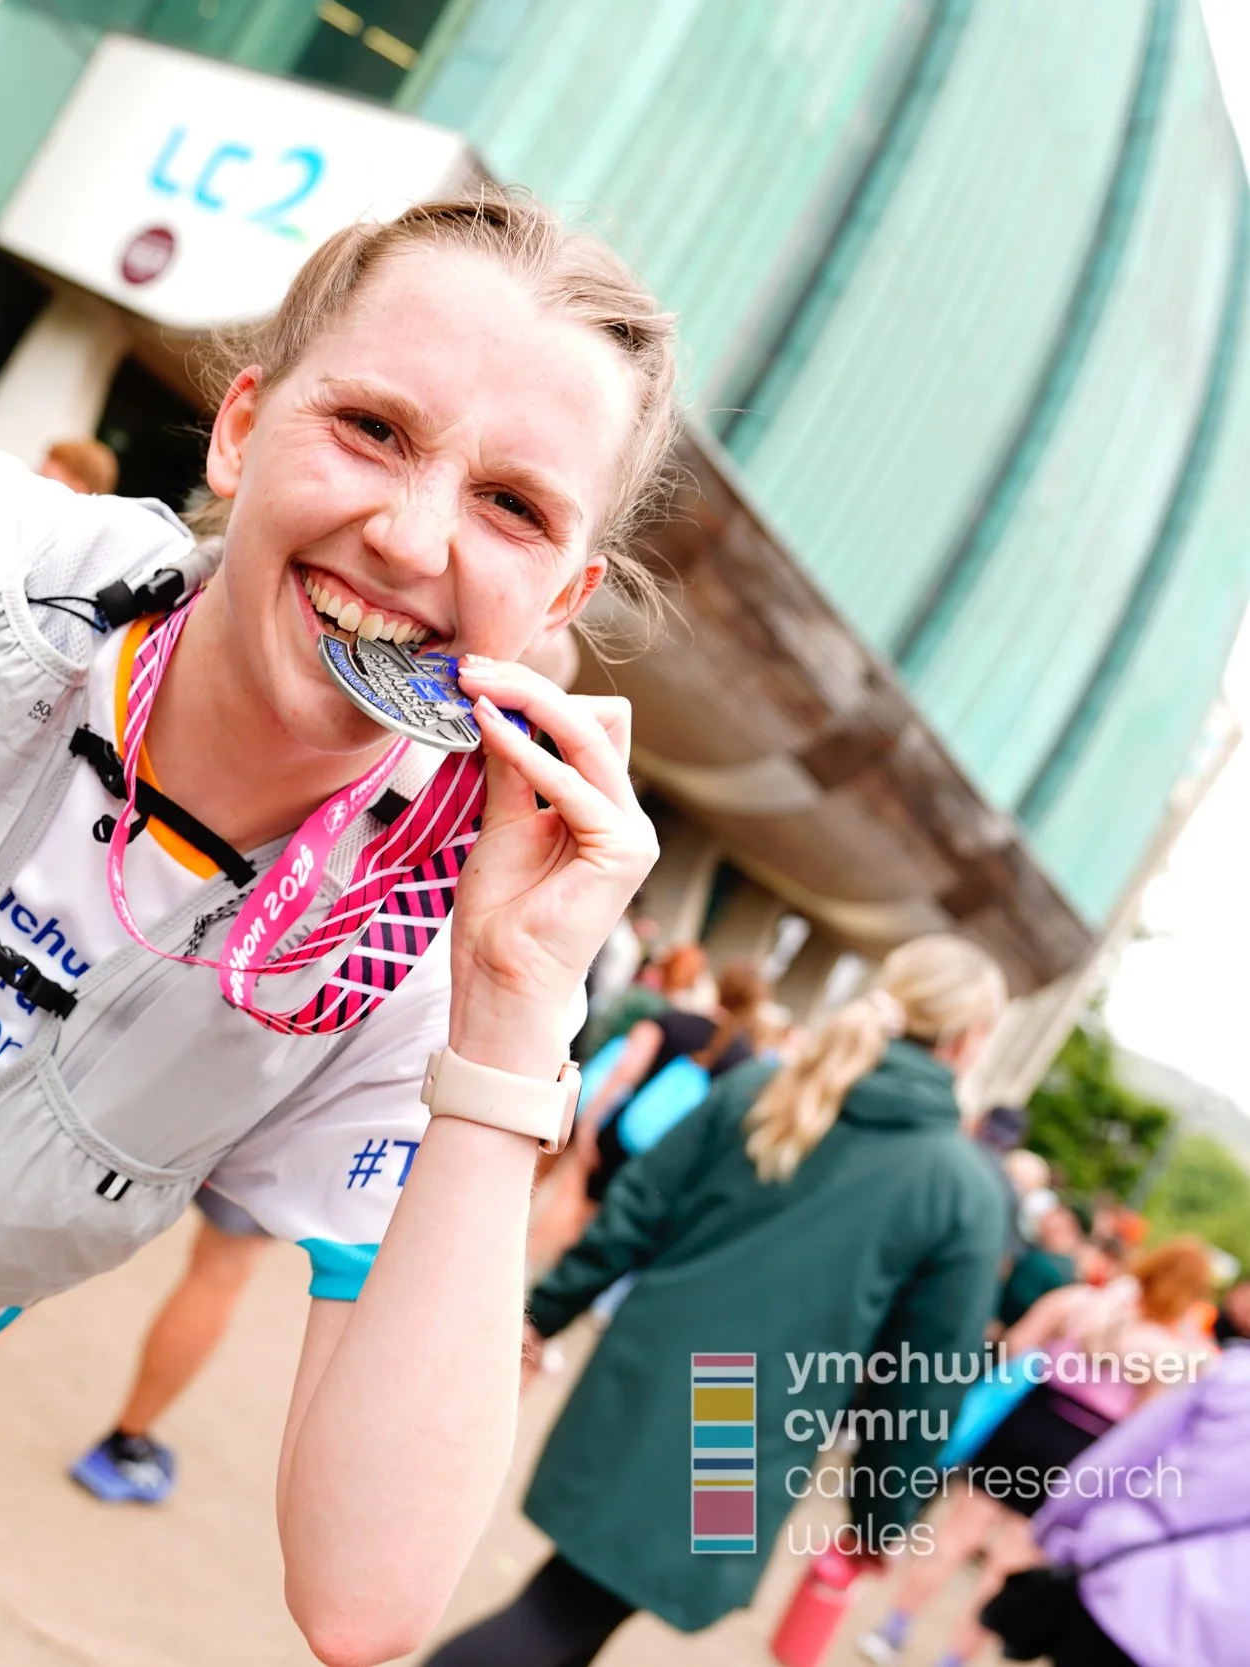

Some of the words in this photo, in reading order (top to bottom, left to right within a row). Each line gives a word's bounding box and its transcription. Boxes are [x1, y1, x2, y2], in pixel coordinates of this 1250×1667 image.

[149, 126, 324, 242] LC2
[369, 653, 439, 726] SWANSEA
[263, 844, 314, 921] 2026
